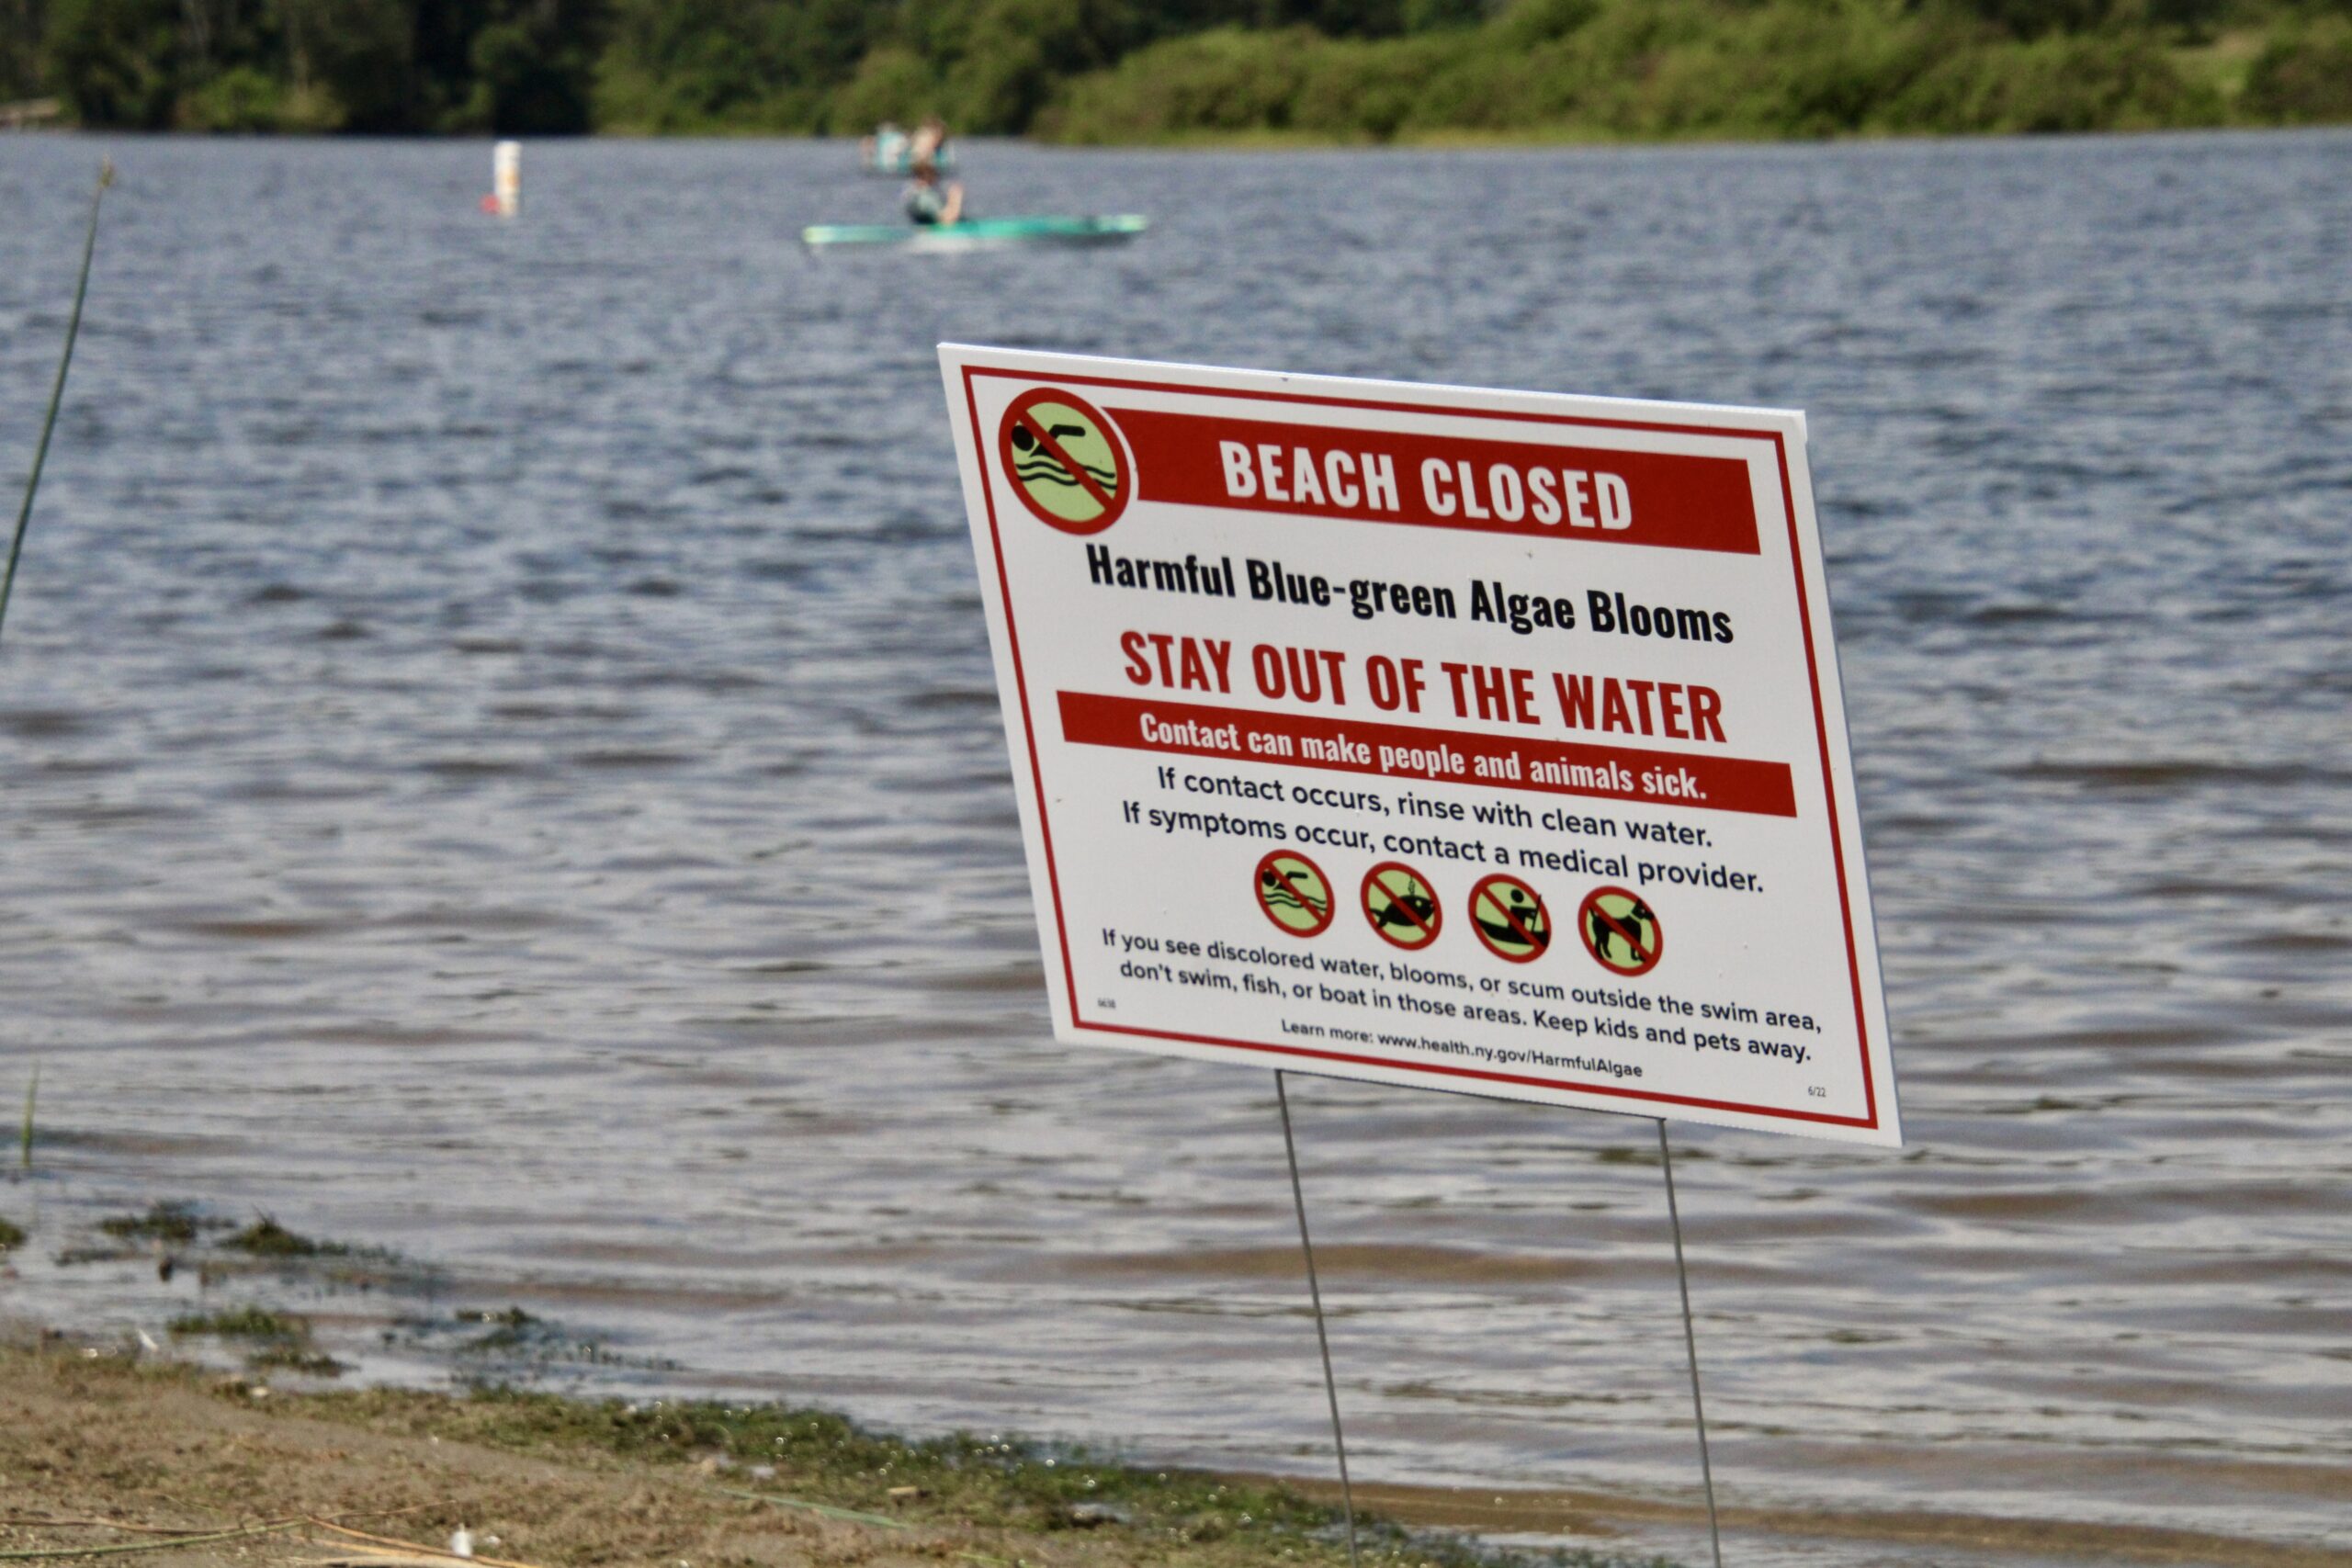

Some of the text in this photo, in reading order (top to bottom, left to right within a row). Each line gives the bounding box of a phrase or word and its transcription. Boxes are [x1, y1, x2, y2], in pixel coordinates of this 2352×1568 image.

[1219, 440, 1632, 530] BEACH CLOSED
[1085, 543, 1734, 644] Harmful Blue-green Algae Blooms
[1120, 630, 1727, 743] STAY OUT OF THE WATER
[1139, 713, 1707, 799] Contact can make people and animals sick.
[1123, 800, 1763, 893] If symptoms occur, contact a medical provider.
[1158, 766, 1712, 848] If contact occurs, rinse with clean water.
[1102, 929, 1821, 1034] If you see discolored water, blooms, or scum outside the swim area,
[1120, 960, 1811, 1065] don't swim, fish, or boat in those areas. Keep kids and pets away.
[1281, 1019, 1644, 1078] Learn more: www.health.ny.gov/HarmfulAlgae
[1807, 1086, 1826, 1099] 6/22
